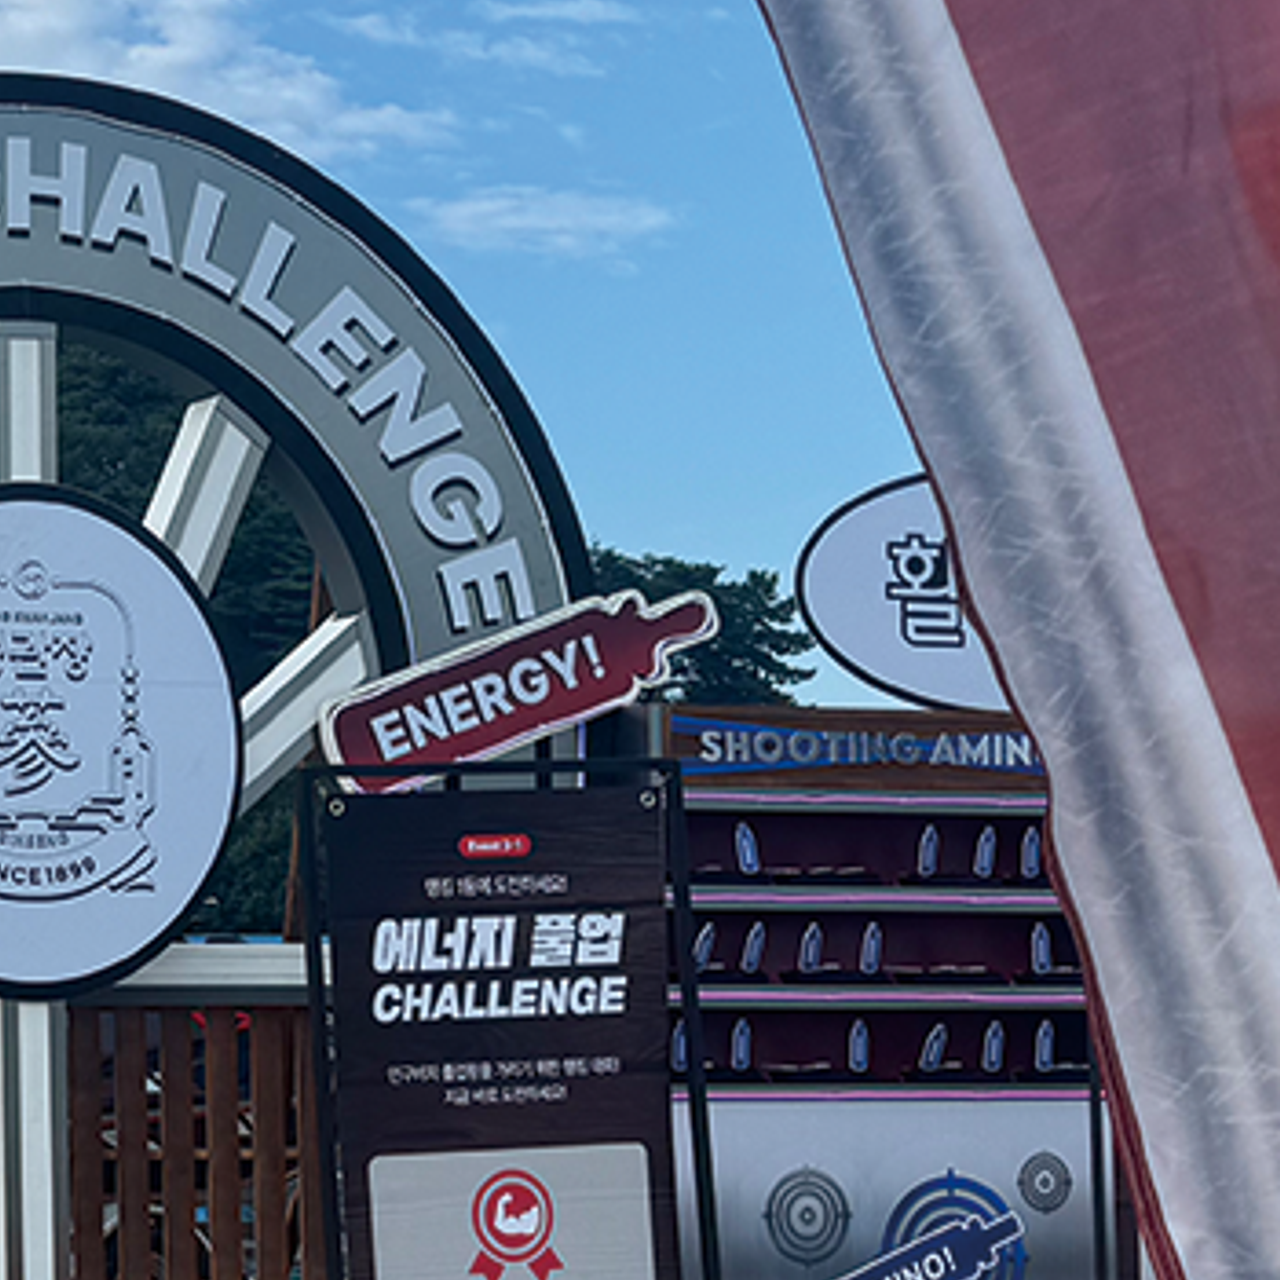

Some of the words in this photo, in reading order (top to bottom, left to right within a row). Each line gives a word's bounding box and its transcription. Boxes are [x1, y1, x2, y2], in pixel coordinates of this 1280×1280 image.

[369, 634, 606, 762] ENERGY!
[699, 730, 922, 764] SHOOTING
[928, 732, 1040, 767] AMIN
[372, 915, 517, 973] 에너지
[530, 913, 625, 968] 풀업
[372, 976, 627, 1023] CHALLENGE
